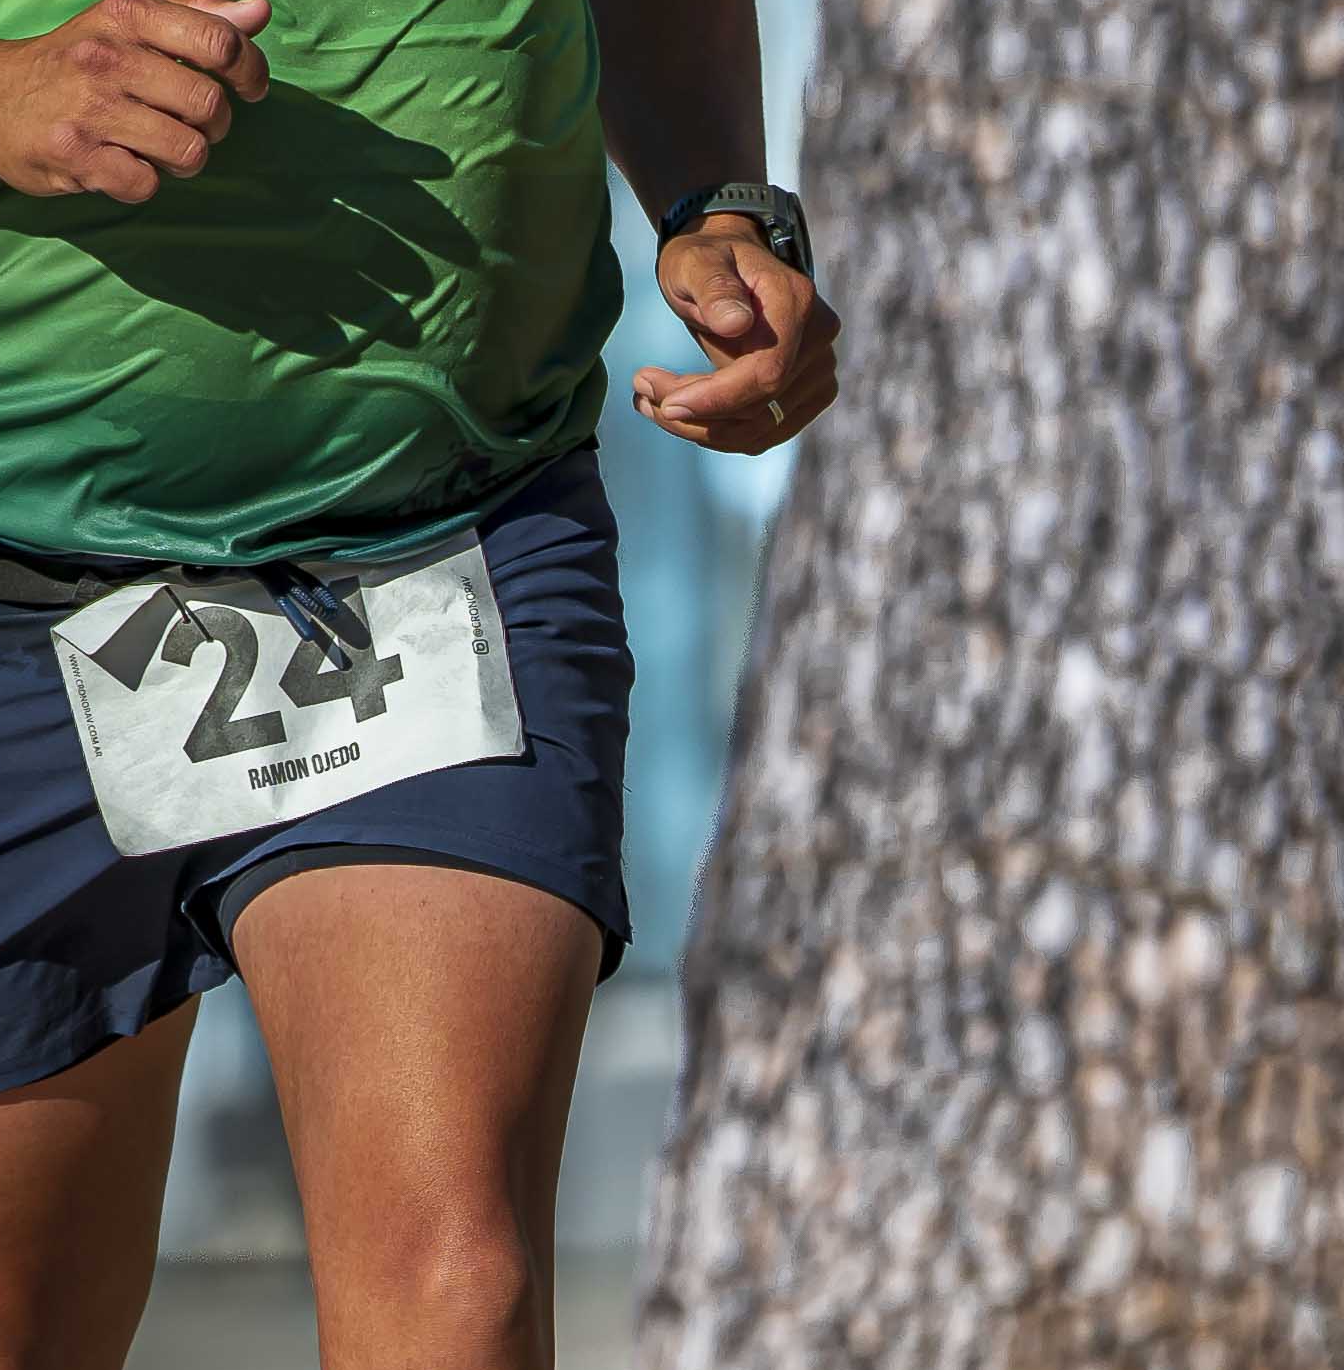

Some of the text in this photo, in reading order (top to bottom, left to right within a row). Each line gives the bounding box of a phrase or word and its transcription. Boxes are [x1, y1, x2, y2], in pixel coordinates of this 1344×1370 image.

[161, 574, 404, 764] 24
[247, 741, 361, 790] RAMON OJEDO
